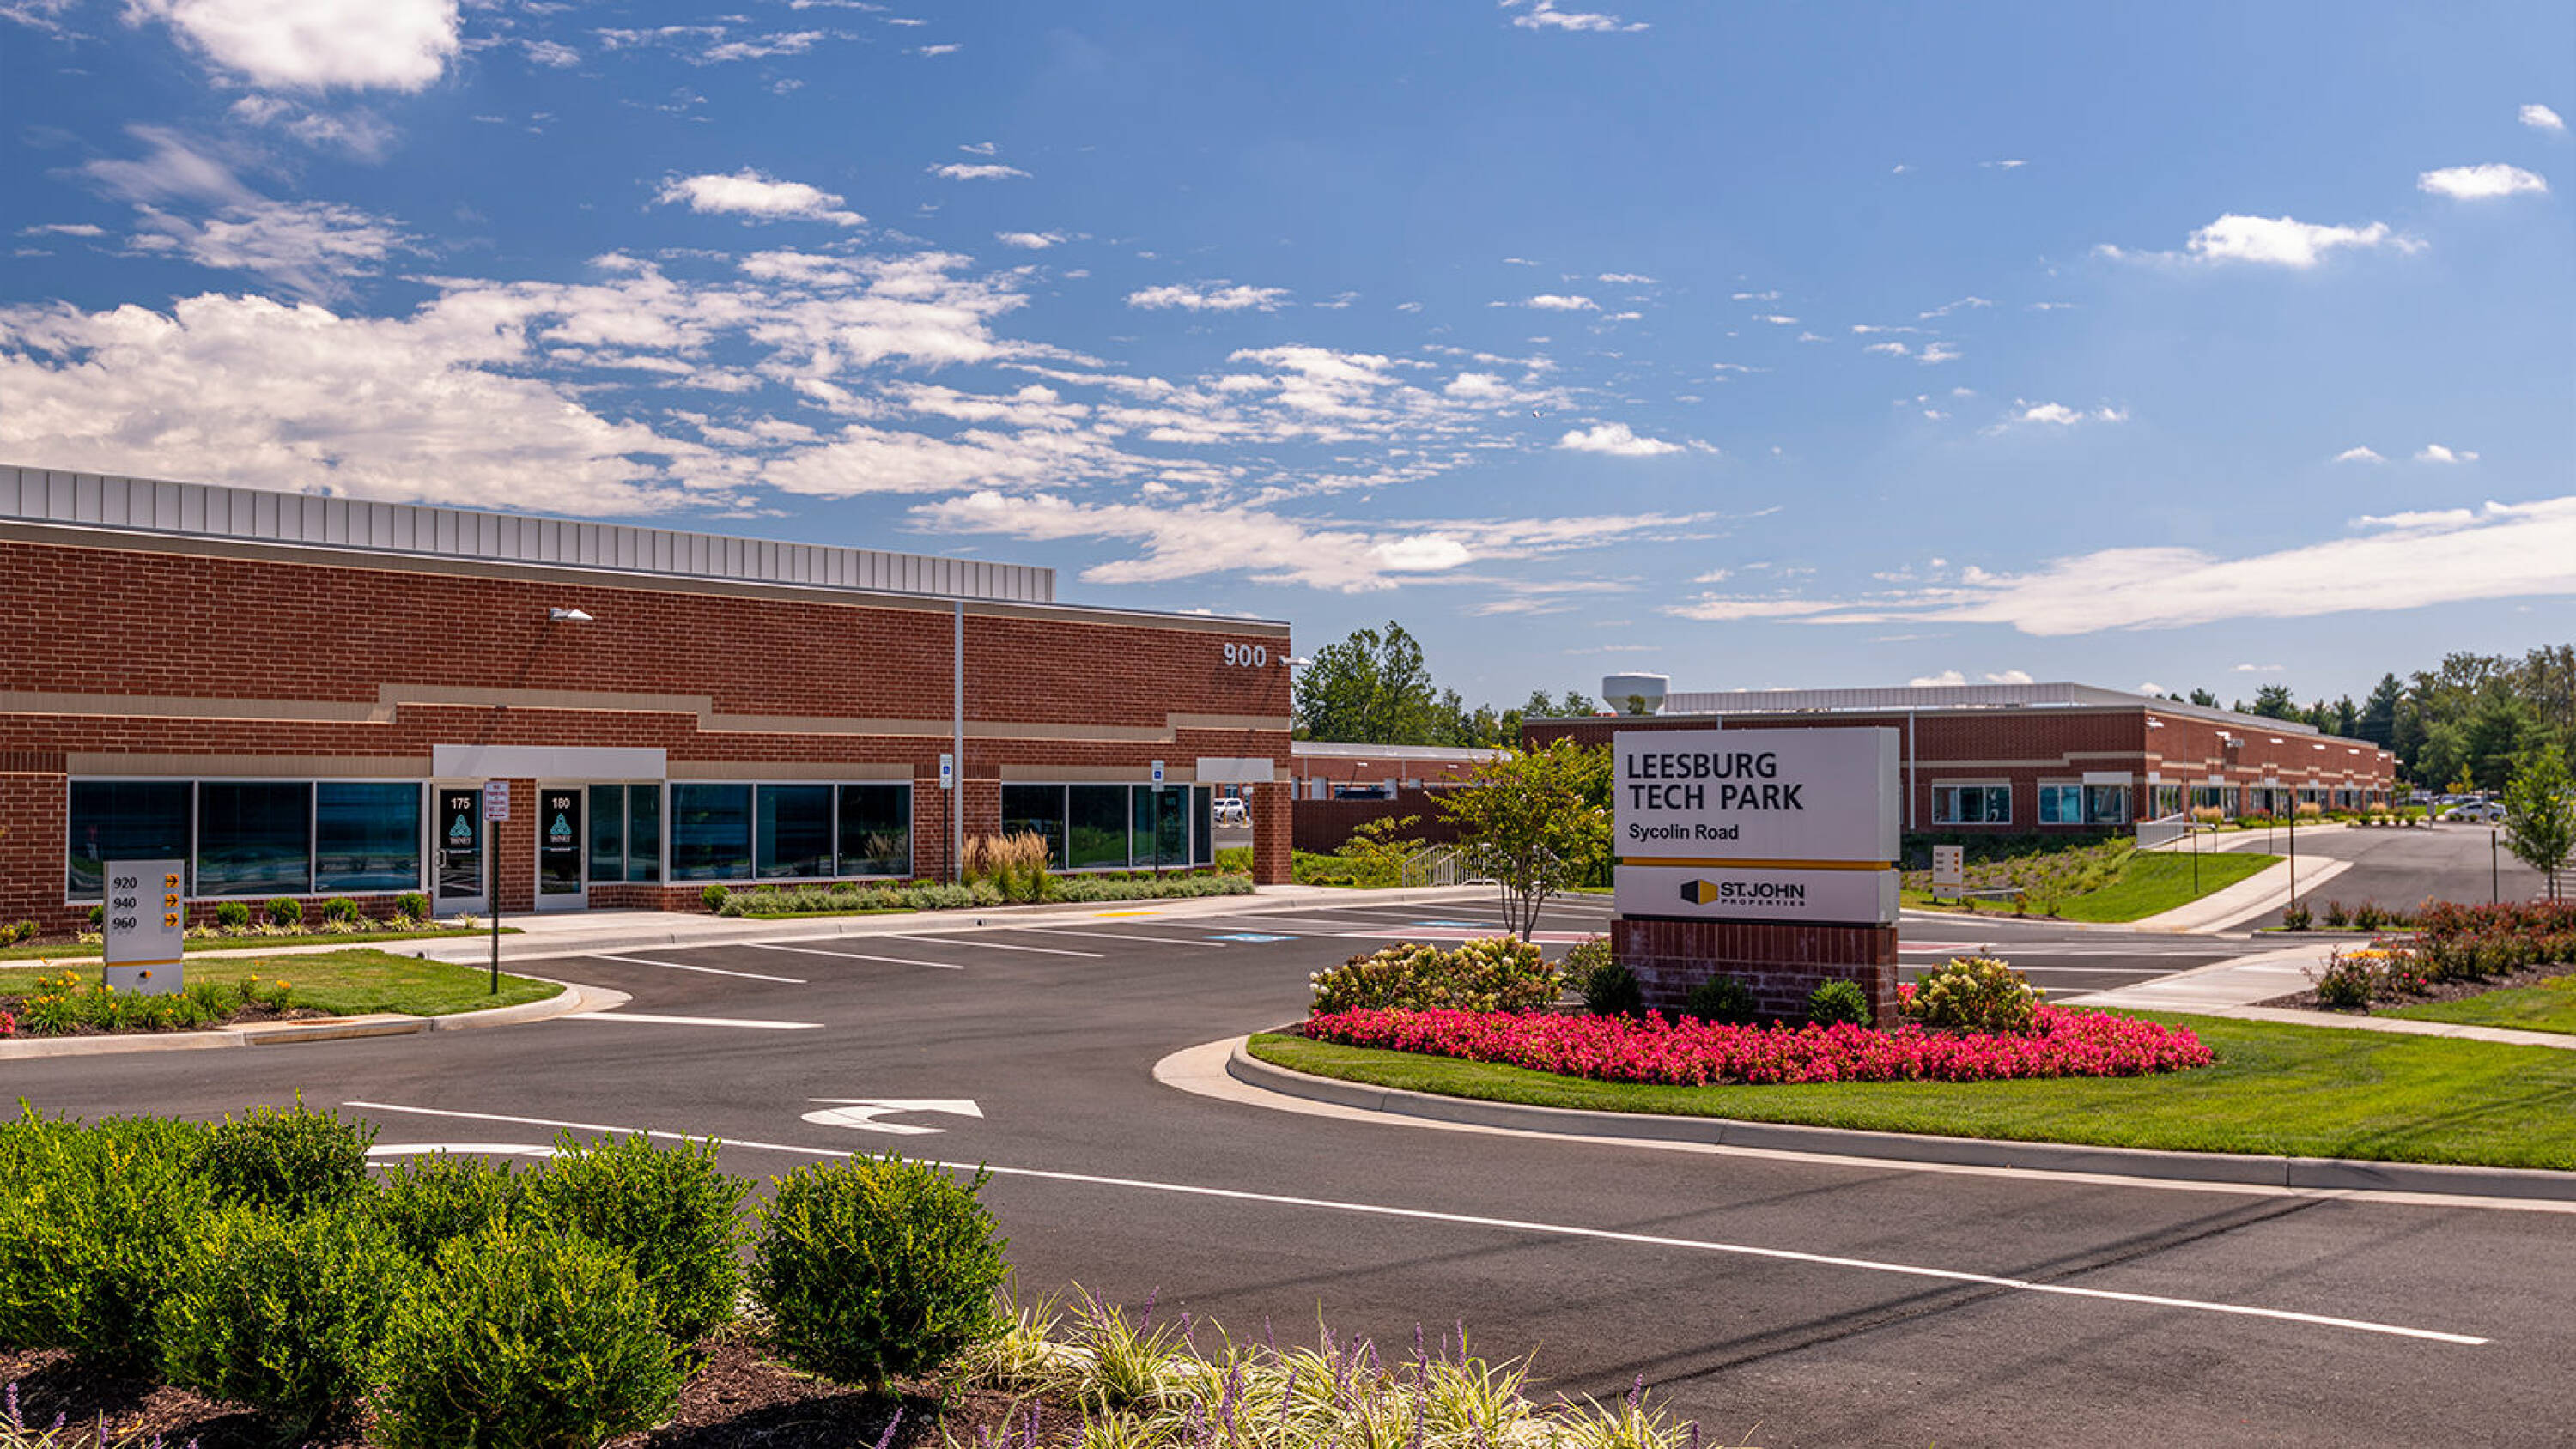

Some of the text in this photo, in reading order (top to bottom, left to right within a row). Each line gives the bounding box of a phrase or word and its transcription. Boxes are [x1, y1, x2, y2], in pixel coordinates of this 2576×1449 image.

[1224, 643, 1267, 668] 900
[1627, 752, 1777, 779] LEESBURG
[451, 797, 471, 809] 175
[551, 797, 571, 809] 180
[1628, 784, 1804, 810] TECH PARK
[1629, 823, 1740, 842] Sycolin Road
[113, 876, 137, 889] 920
[113, 896, 137, 909] 940
[1721, 899, 1806, 907] PROPERTIES
[112, 916, 137, 929] 960
